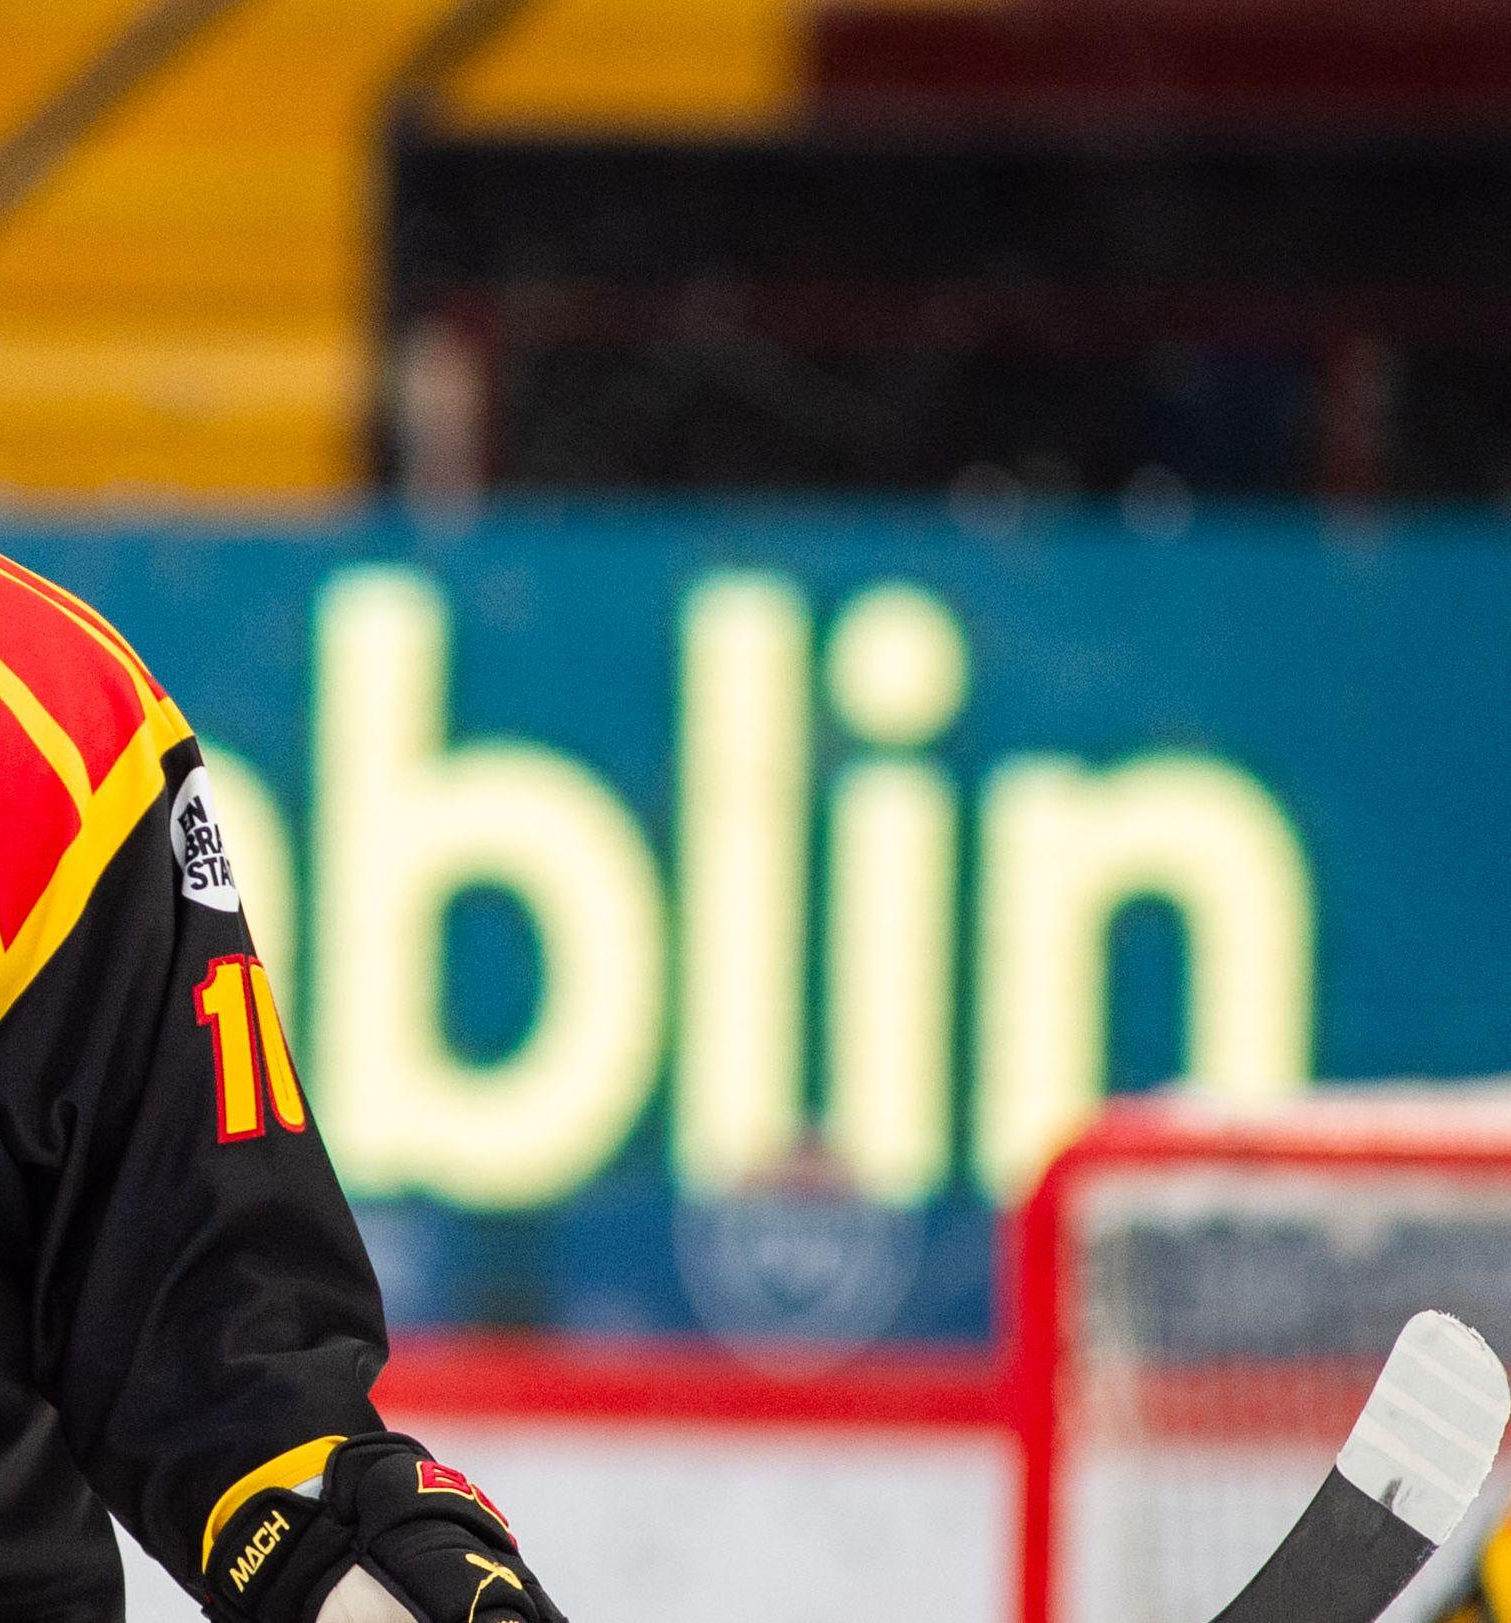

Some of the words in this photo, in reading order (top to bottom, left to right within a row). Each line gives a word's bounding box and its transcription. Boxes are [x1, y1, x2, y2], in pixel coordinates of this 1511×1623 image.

[177, 795, 208, 834] EN
[192, 953, 306, 1144] 10
[229, 1510, 290, 1593] MACH
